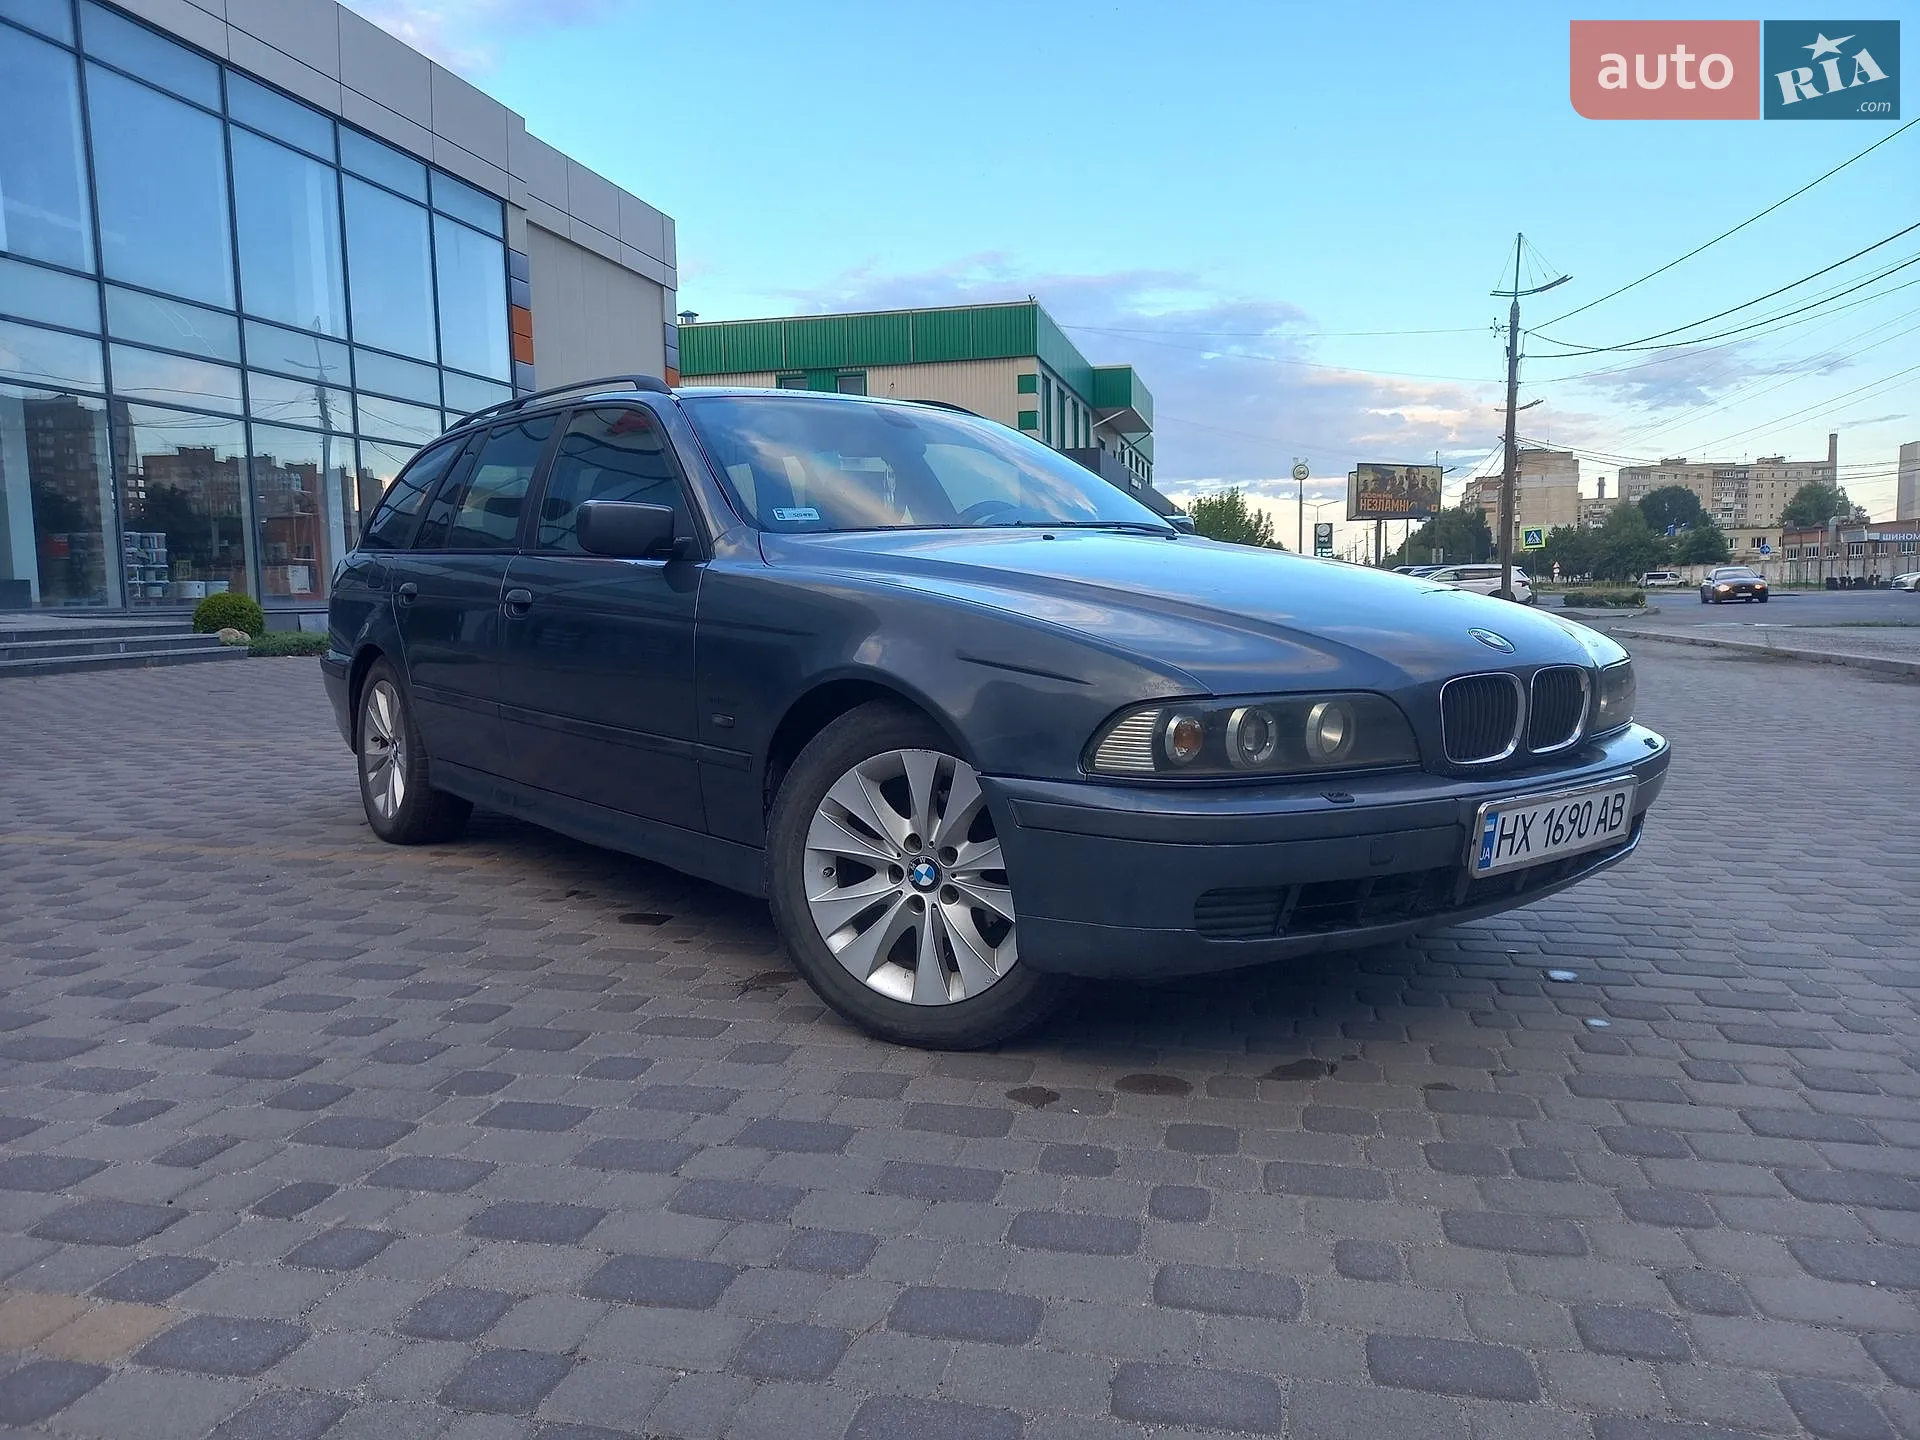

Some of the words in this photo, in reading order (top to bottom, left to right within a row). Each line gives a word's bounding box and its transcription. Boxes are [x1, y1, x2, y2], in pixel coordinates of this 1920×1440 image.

[1496, 811, 1538, 858] HX
[1543, 800, 1593, 848] 1690
[1593, 792, 1626, 836] AB
